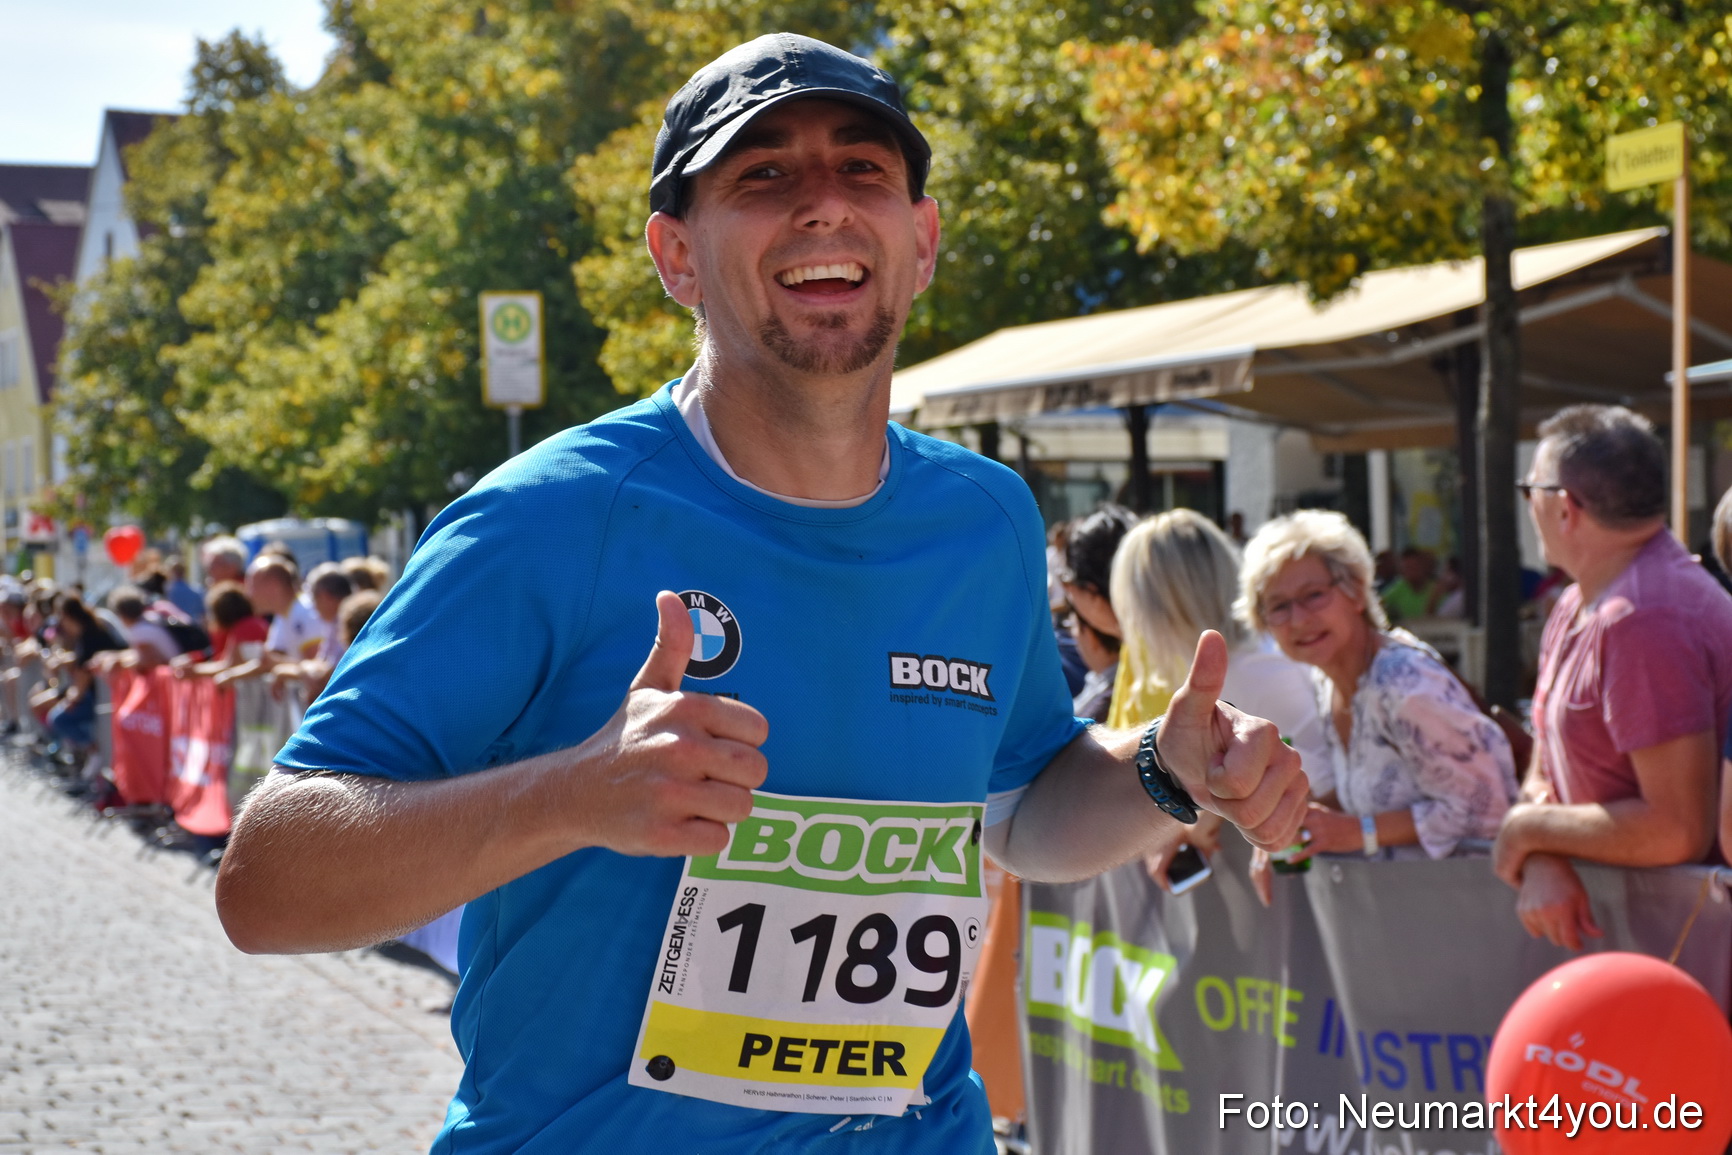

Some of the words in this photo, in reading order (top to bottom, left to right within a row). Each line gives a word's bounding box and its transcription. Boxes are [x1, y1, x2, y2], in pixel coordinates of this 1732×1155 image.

[890, 654, 992, 698] BOCK
[890, 691, 930, 704] inspired
[932, 694, 943, 706] by
[944, 697, 967, 709] smart
[967, 702, 998, 716] concepts
[722, 811, 969, 881] BOCK
[677, 942, 694, 996] TRANSPONDER
[690, 887, 709, 937] ZEITMESSUNG
[716, 902, 961, 1008] 1189
[968, 925, 977, 941] C
[738, 1032, 908, 1077] PETER
